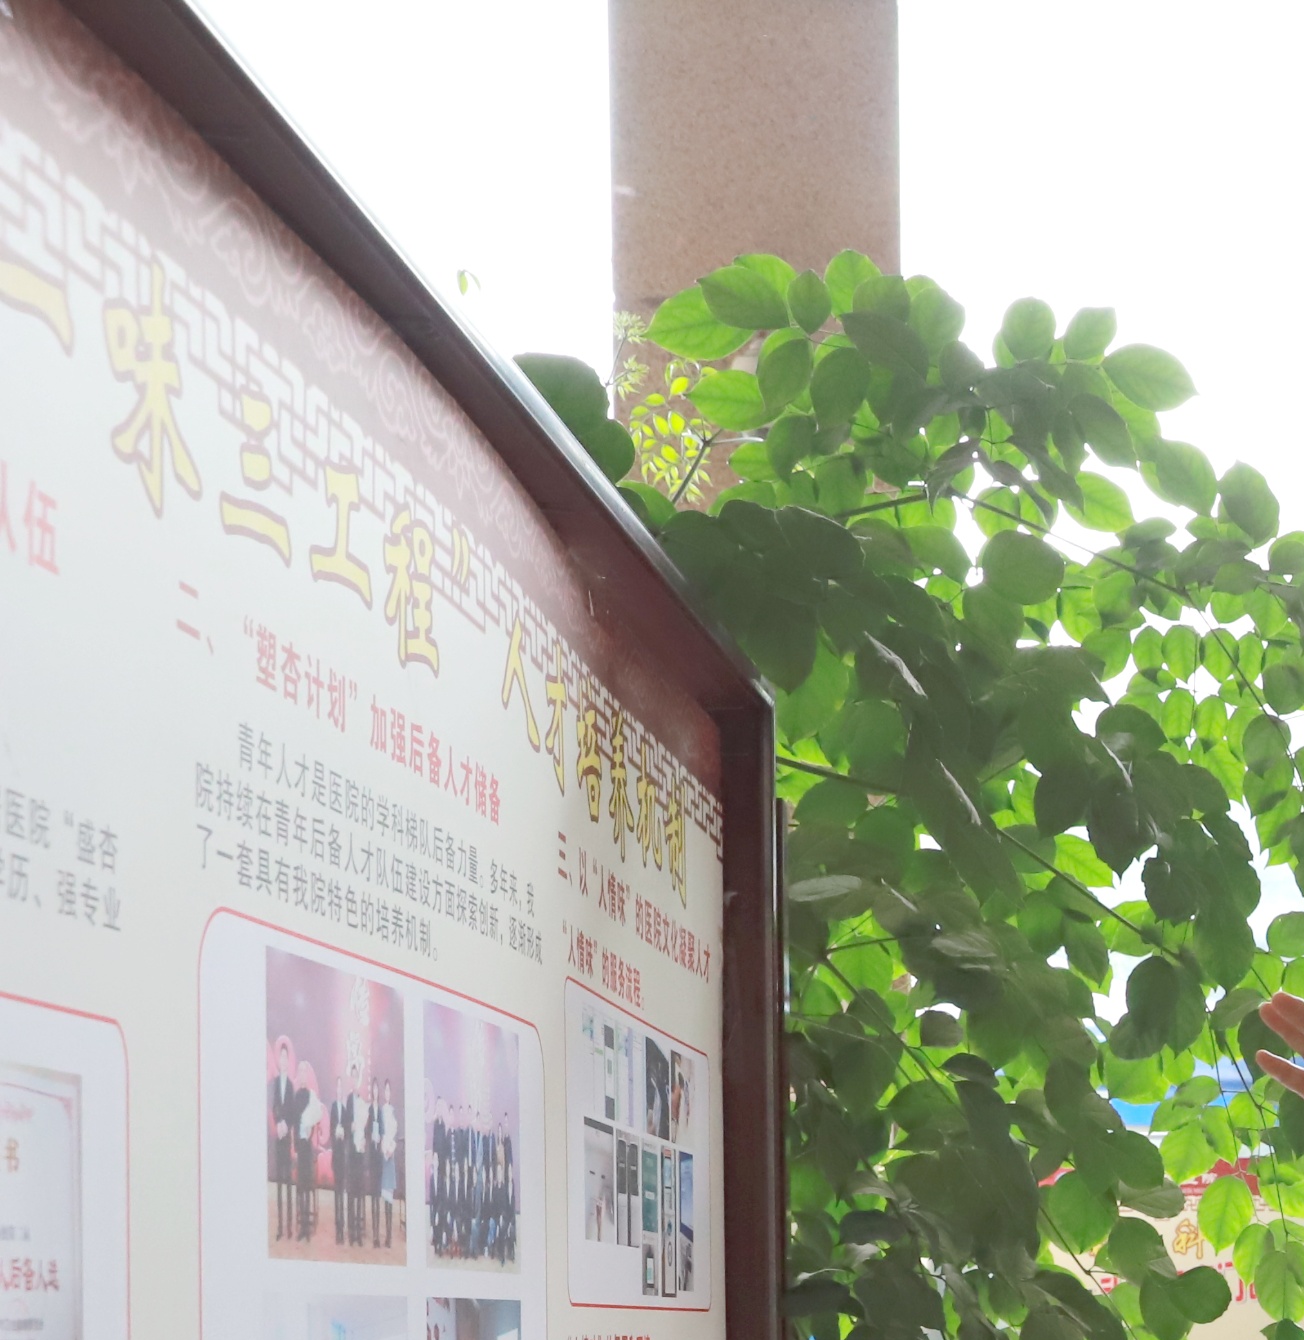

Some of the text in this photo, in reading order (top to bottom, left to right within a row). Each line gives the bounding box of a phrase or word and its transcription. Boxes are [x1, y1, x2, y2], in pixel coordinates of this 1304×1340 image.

[196, 823, 438, 962] 了一套具有我院特色的培养机制。
